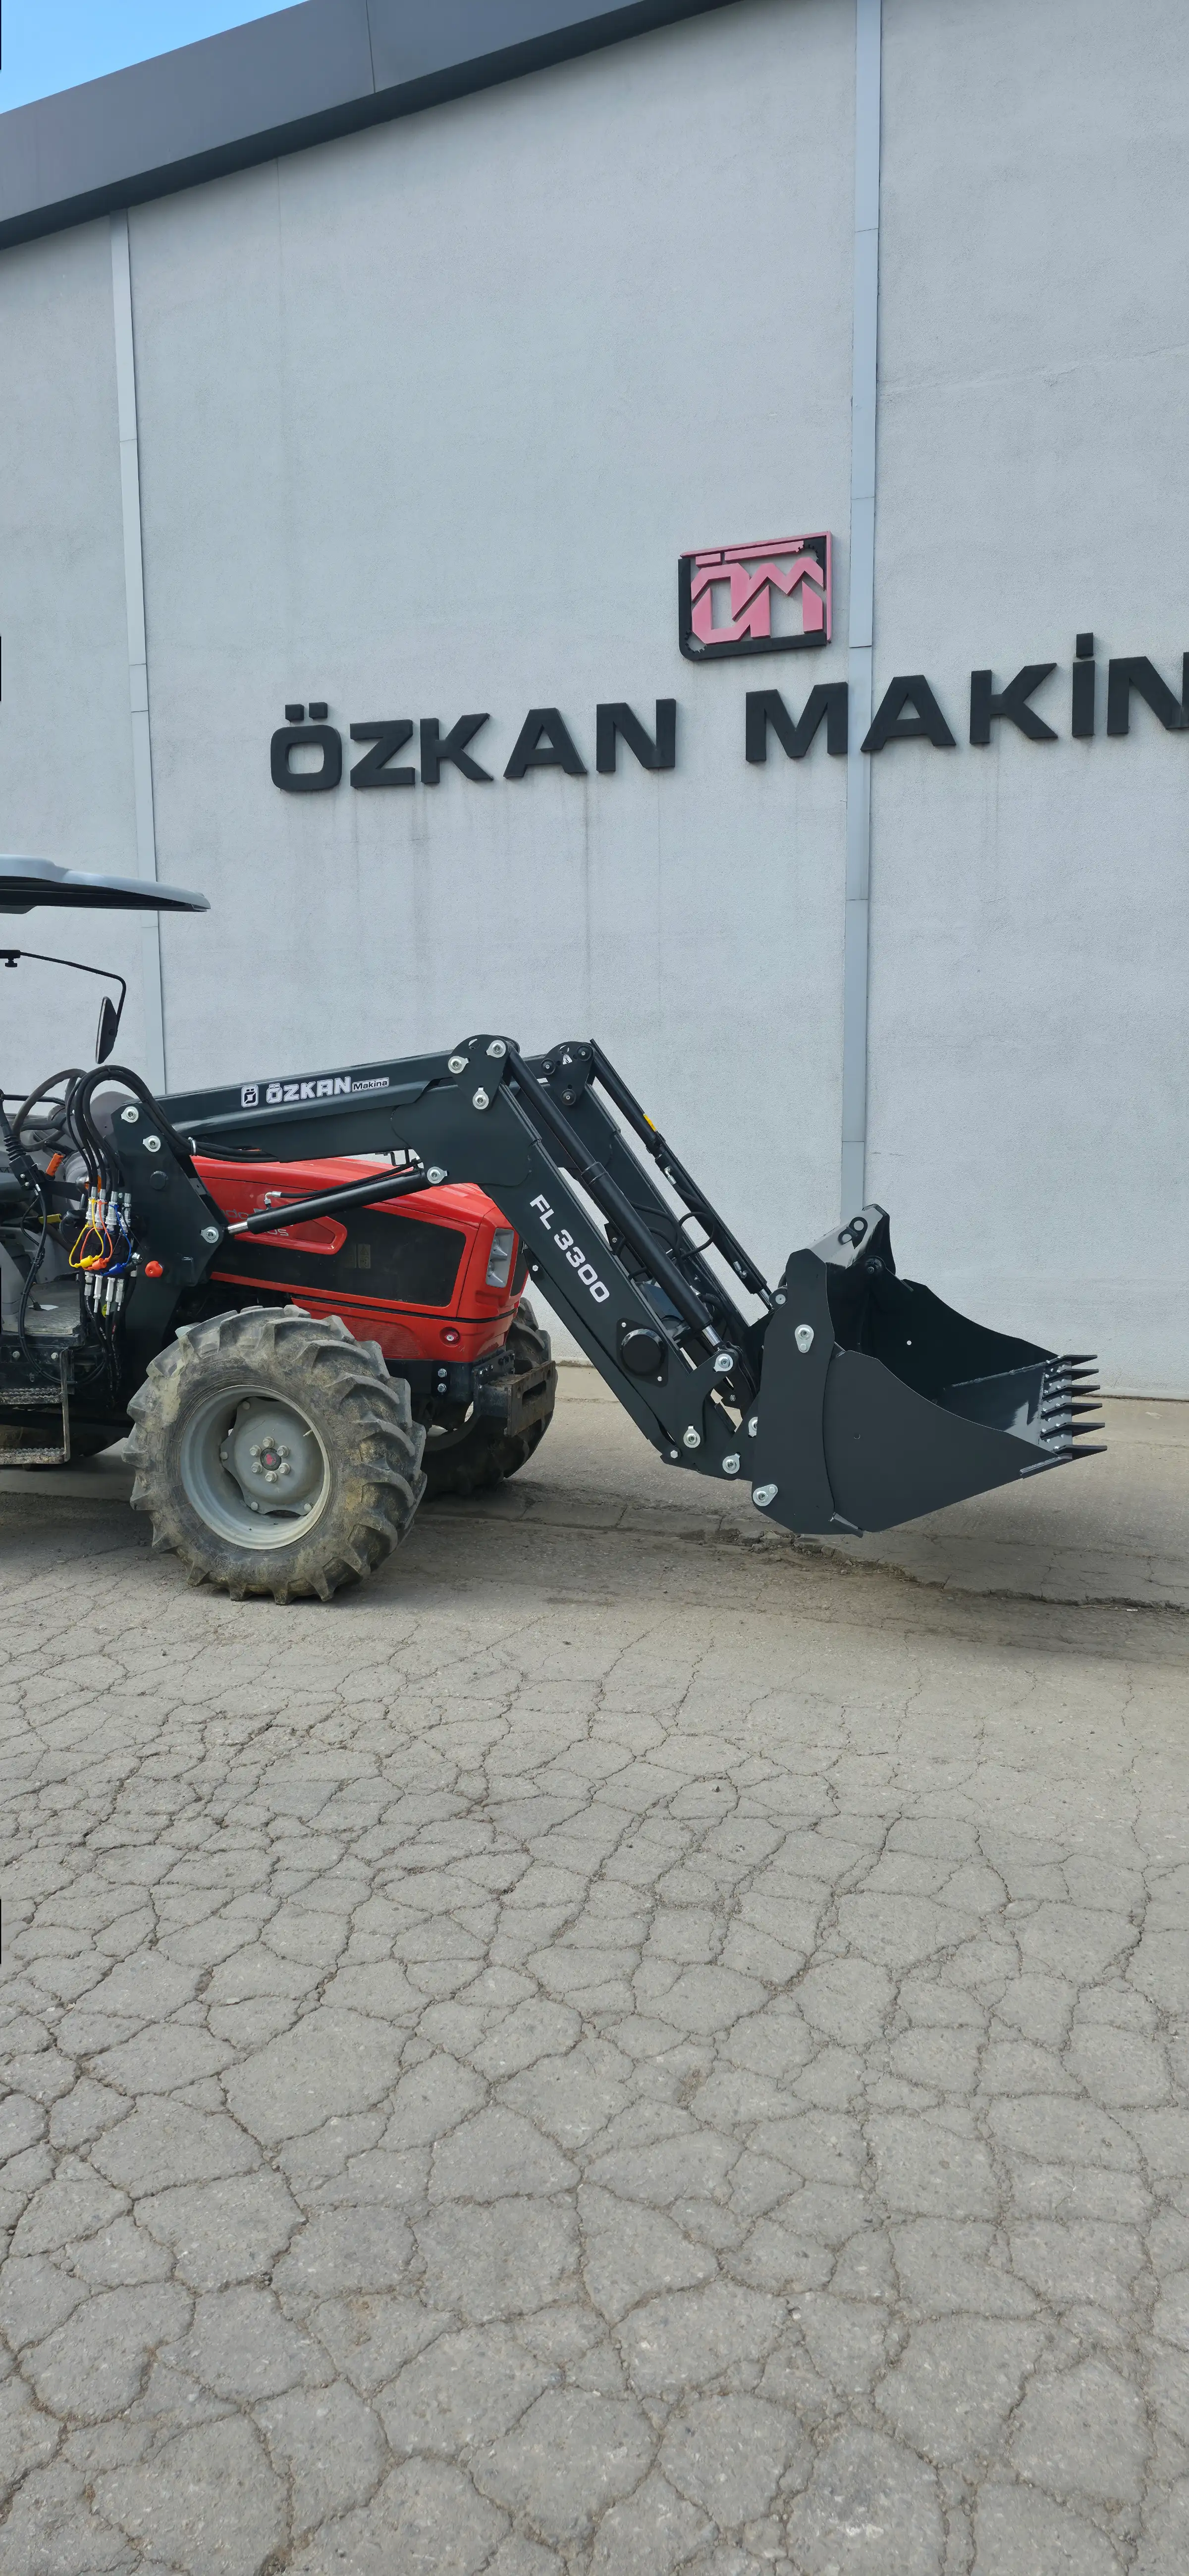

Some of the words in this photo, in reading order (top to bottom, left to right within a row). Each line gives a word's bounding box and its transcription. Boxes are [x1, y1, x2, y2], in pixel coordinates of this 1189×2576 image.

[270, 698, 676, 793] ÖZKAN
[746, 632, 1189, 762] MAKİN
[266, 1076, 351, 1104] ÖZKAN
[353, 1079, 388, 1091] Makina
[530, 1194, 554, 1230] FL
[554, 1229, 610, 1303] 3300
